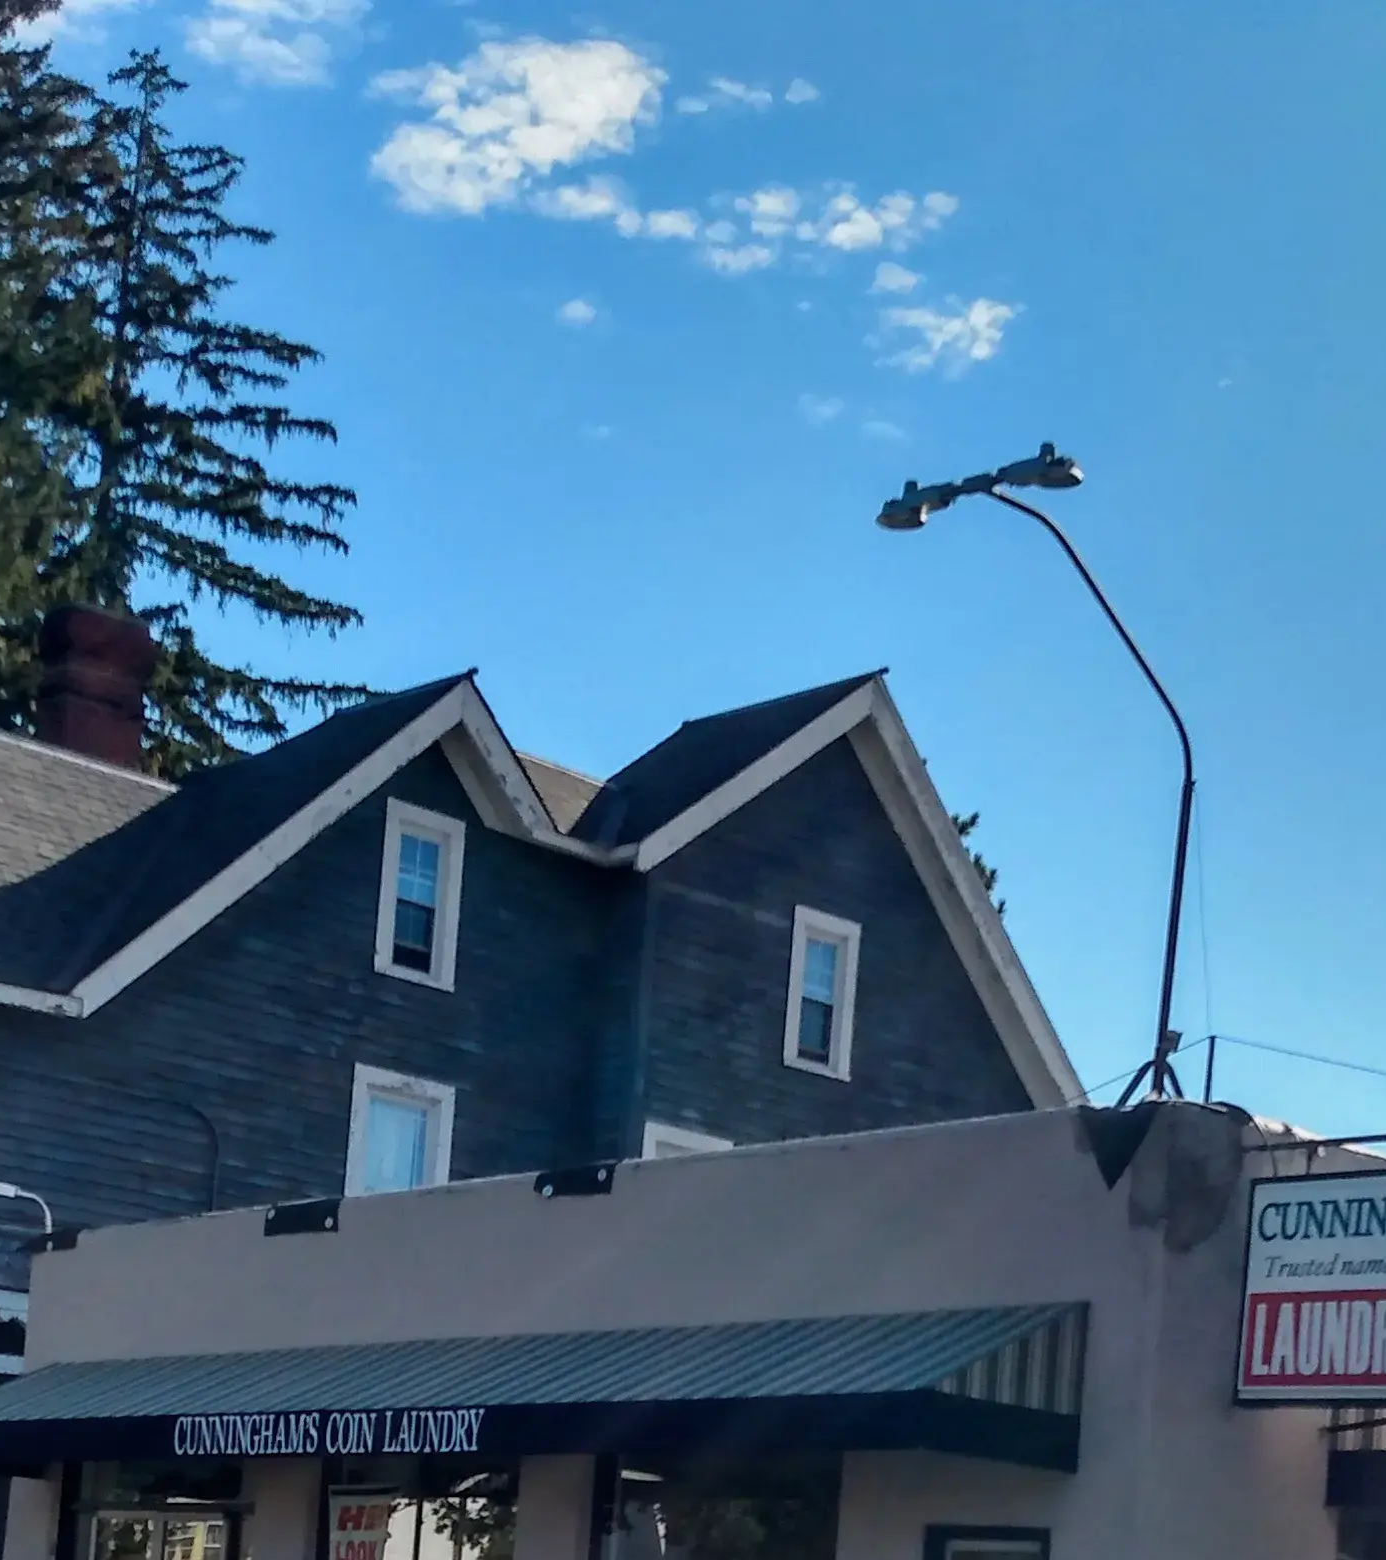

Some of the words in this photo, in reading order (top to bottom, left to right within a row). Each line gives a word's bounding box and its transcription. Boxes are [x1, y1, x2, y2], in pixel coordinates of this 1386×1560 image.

[1264, 1252, 1337, 1279] Trusted
[174, 1411, 320, 1456] CUNNINGHAM'S
[325, 1410, 378, 1455] COIN
[382, 1408, 486, 1454] LAUNDRY
